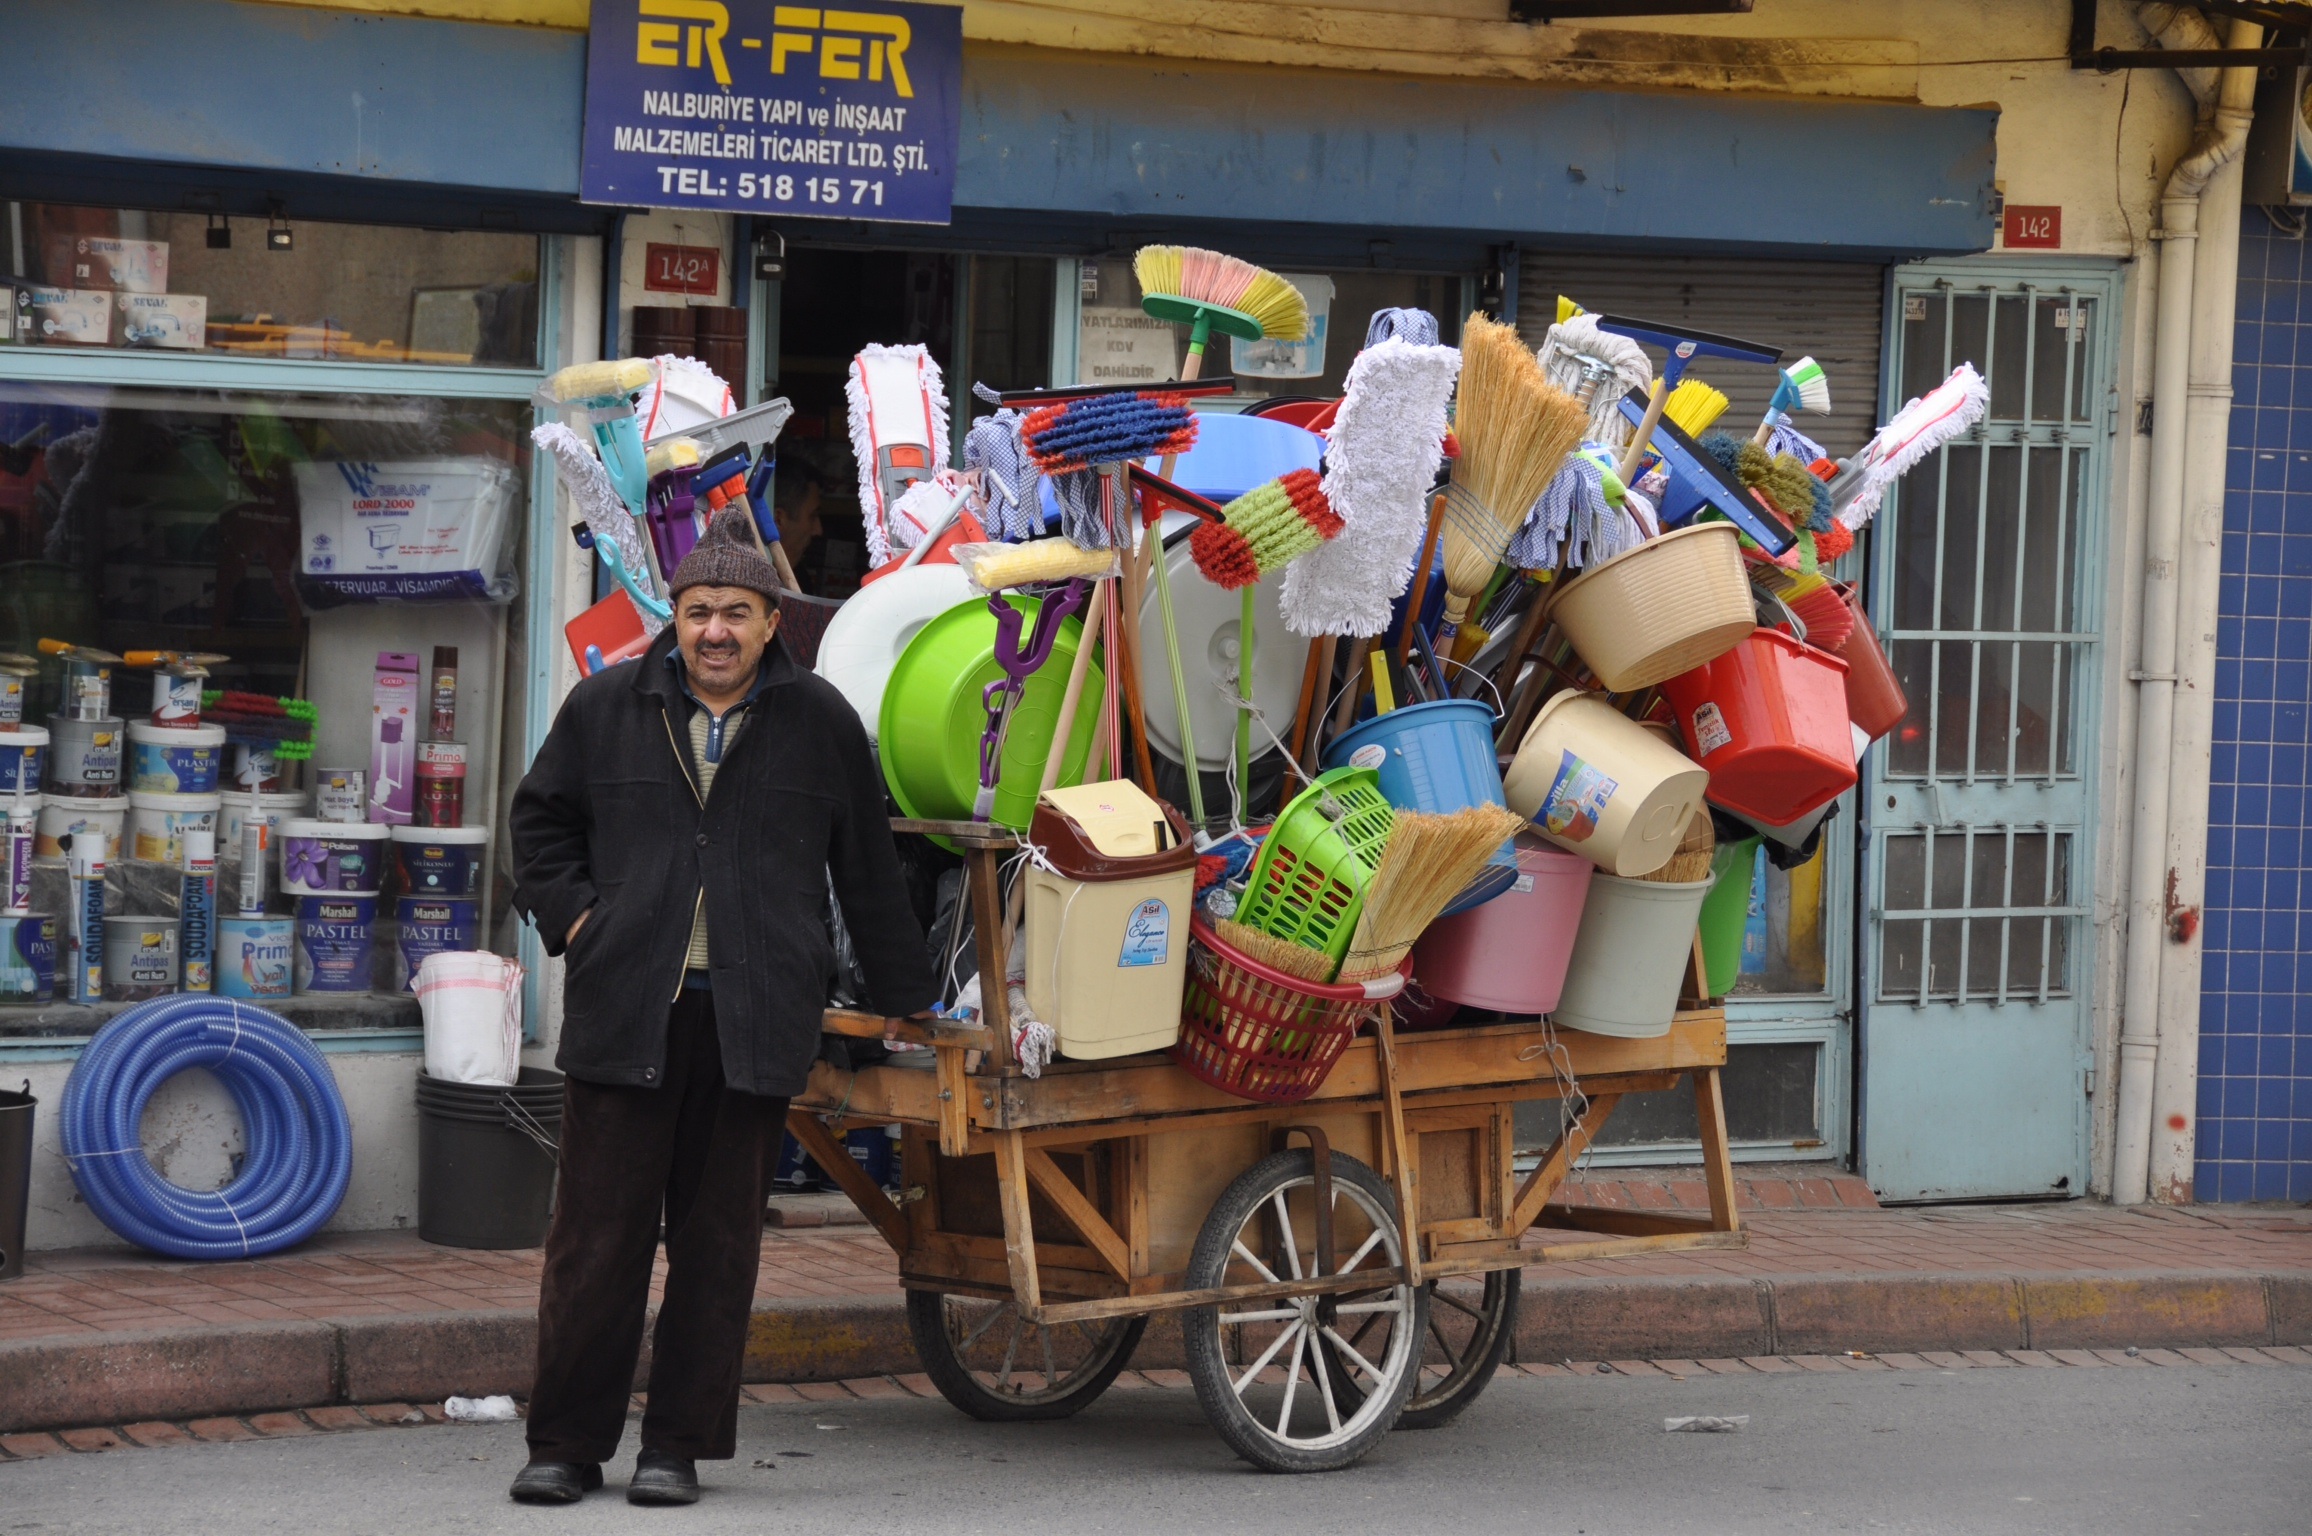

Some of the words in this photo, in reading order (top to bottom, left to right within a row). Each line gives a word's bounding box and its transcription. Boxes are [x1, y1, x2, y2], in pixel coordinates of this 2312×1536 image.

[643, 89, 754, 123] NALBURİYE
[759, 98, 803, 126] YAPI
[807, 106, 830, 127] ve
[834, 96, 907, 136] İNŞAAT
[614, 125, 755, 160] MALZEMELERİ
[760, 129, 843, 165] TİCARET
[847, 141, 887, 168] LTD.
[893, 139, 929, 176] ŞTİ.
[657, 166, 728, 197] TEL:
[737, 172, 794, 201] 518
[804, 176, 841, 204] 15
[849, 179, 884, 206] 71
[2019, 216, 2050, 238] 142
[1106, 340, 1134, 353] KDV
[1093, 363, 1155, 379] DAHİLDİR
[353, 500, 381, 510] LORD
[384, 499, 415, 509] 2000
[382, 678, 403, 686] GOLD
[86, 771, 100, 779] Anti
[101, 771, 114, 779] Rust
[328, 842, 359, 851] Polisan
[185, 876, 207, 959] SOUDAFOAM
[319, 905, 357, 918] Marshall
[413, 906, 451, 920] Marshall
[85, 878, 102, 964] SOUDAFOAM
[306, 924, 367, 939] PASTEL
[402, 925, 462, 941] PASTEL
[1129, 919, 1165, 948] Elegance
[130, 954, 169, 969] Antipas
[135, 971, 150, 980] Anti
[150, 971, 165, 980] Rust
